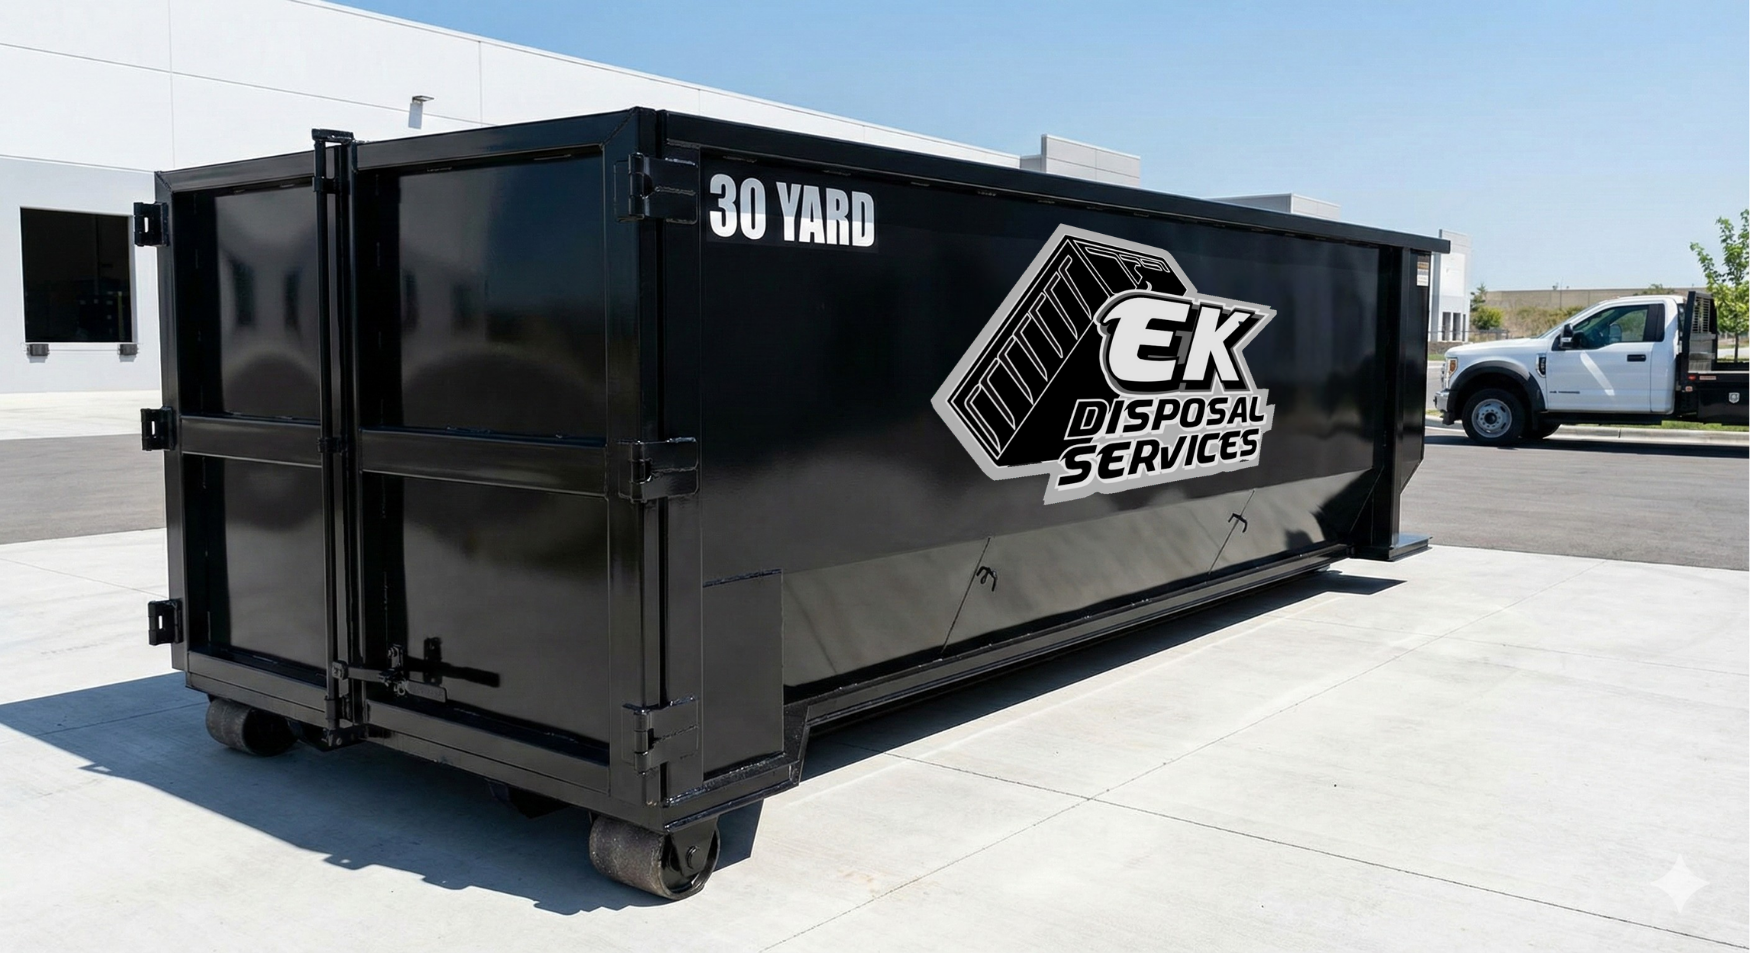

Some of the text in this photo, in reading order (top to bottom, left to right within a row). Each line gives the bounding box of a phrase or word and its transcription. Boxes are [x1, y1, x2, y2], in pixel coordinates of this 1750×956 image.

[709, 173, 875, 247] 30 YARD
[1101, 295, 1255, 386] EK
[1066, 396, 1265, 438] DISPOSAL
[1057, 428, 1260, 487] SERVICES
